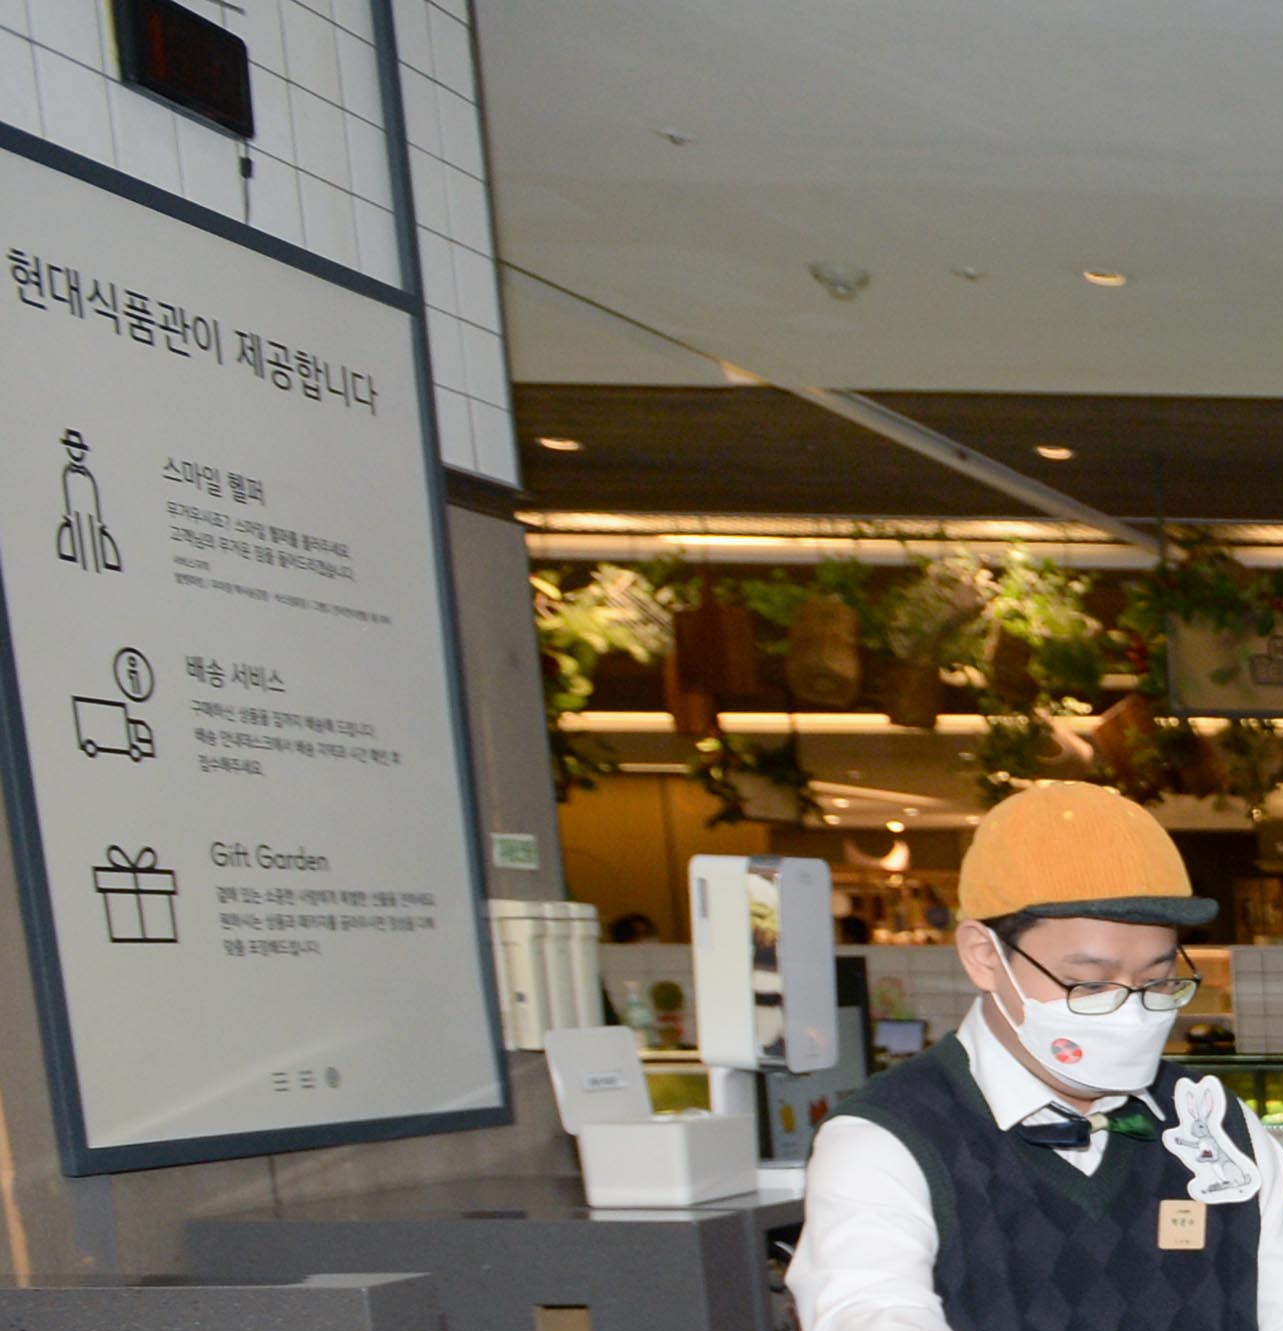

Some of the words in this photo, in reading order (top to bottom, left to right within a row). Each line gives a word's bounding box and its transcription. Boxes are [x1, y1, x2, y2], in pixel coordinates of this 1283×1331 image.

[5, 248, 223, 365] 현대식품관이
[233, 328, 378, 416] 제공합니다
[161, 457, 222, 498] 스마일
[226, 471, 266, 506] 헬퍼
[185, 655, 225, 689] 배송
[231, 662, 286, 693] 서비스
[210, 841, 252, 868] Gift
[255, 843, 331, 872] Garden
